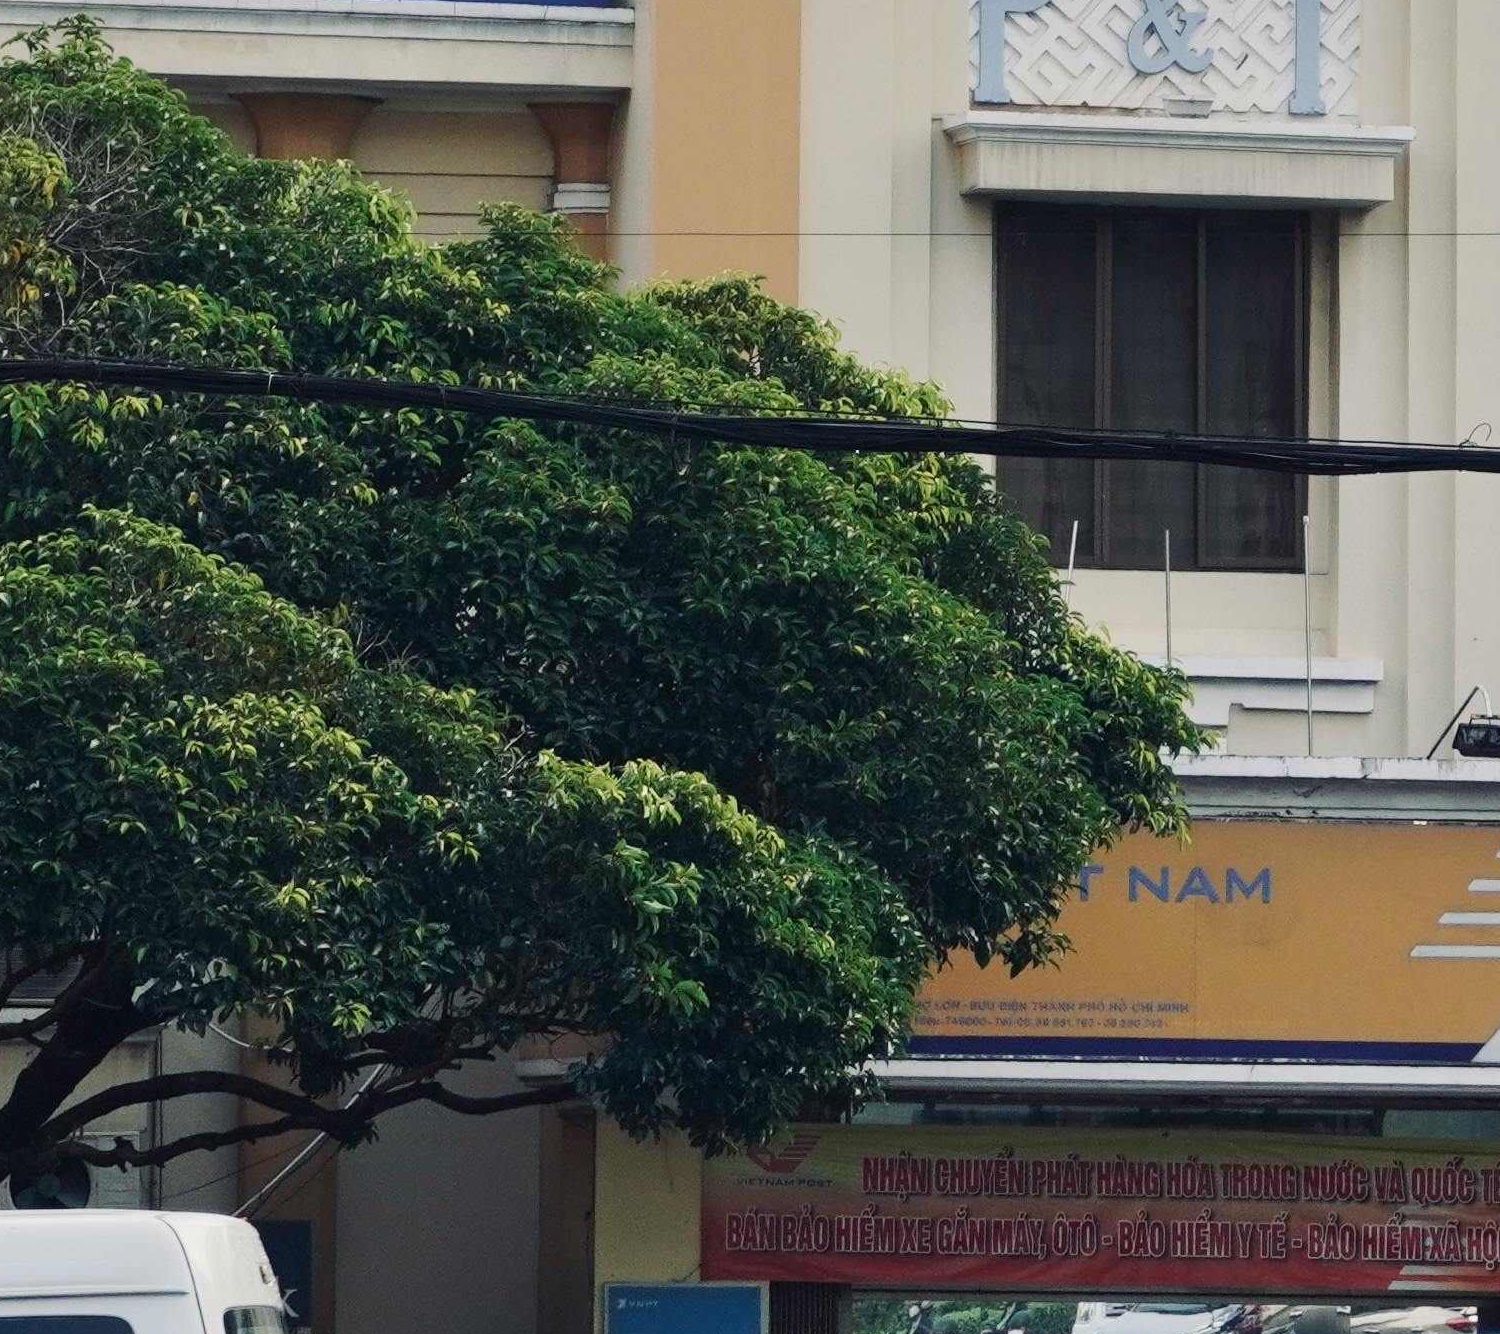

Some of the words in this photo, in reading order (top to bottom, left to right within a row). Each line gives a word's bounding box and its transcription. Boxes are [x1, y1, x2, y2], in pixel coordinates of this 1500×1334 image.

[1128, 866, 1272, 904] NAM
[861, 1151, 933, 1203] NHẬN
[934, 1145, 1030, 1197] CHUYỂN
[1031, 1152, 1094, 1198] PHÁT
[1096, 1154, 1161, 1198] HÀNG
[1221, 1161, 1299, 1202] TRONG
[1301, 1156, 1373, 1204] NƯỚC
[1375, 1159, 1406, 1204] VÀ
[1411, 1155, 1476, 1208] QUỐC
[725, 1206, 777, 1252] BÁN
[781, 1203, 830, 1254] BẢO
[833, 1200, 897, 1255] HIỂM
[900, 1215, 933, 1255] XE
[991, 1210, 1047, 1260] MÁY,
[1051, 1212, 1098, 1257] ÔTÔ
[1117, 1208, 1165, 1259] BẢO
[1169, 1207, 1231, 1259] HIỂM
[1236, 1220, 1257, 1259] Y
[1258, 1211, 1289, 1259] TẾ
[1307, 1210, 1358, 1260] BẢO
[1361, 1211, 1424, 1262] HIỂM
[1426, 1220, 1462, 1262] XÃ
